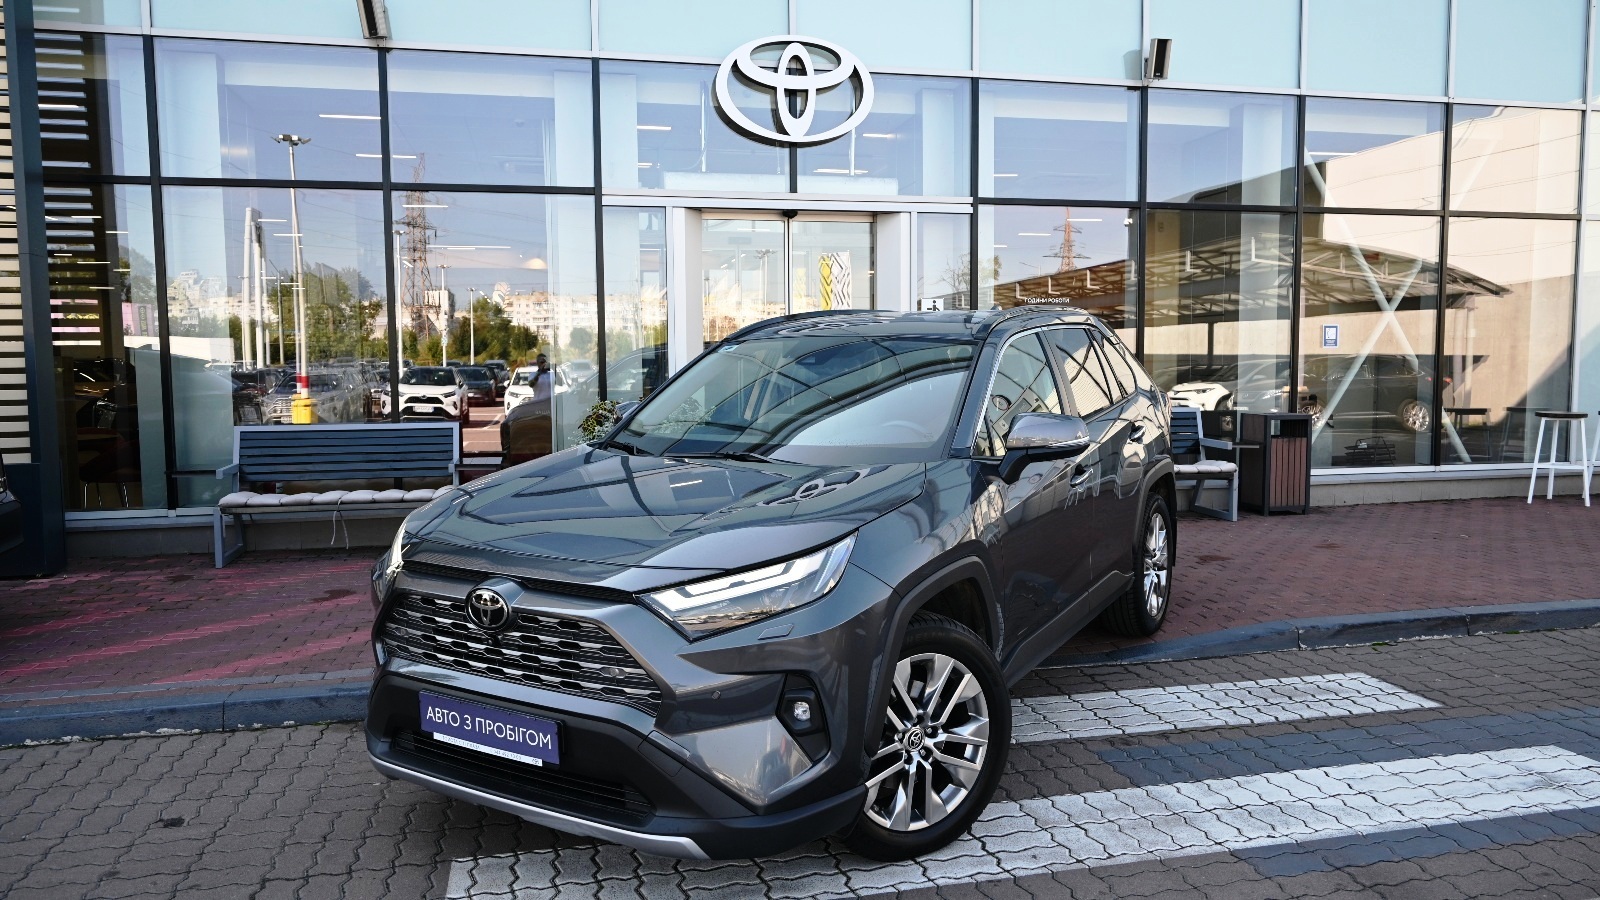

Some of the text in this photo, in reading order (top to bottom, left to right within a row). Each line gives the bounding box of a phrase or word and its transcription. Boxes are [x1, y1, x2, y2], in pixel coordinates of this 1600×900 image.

[426, 706, 460, 727] АВТО
[463, 714, 472, 730] З
[475, 718, 552, 750] ПРОБІГОМ
